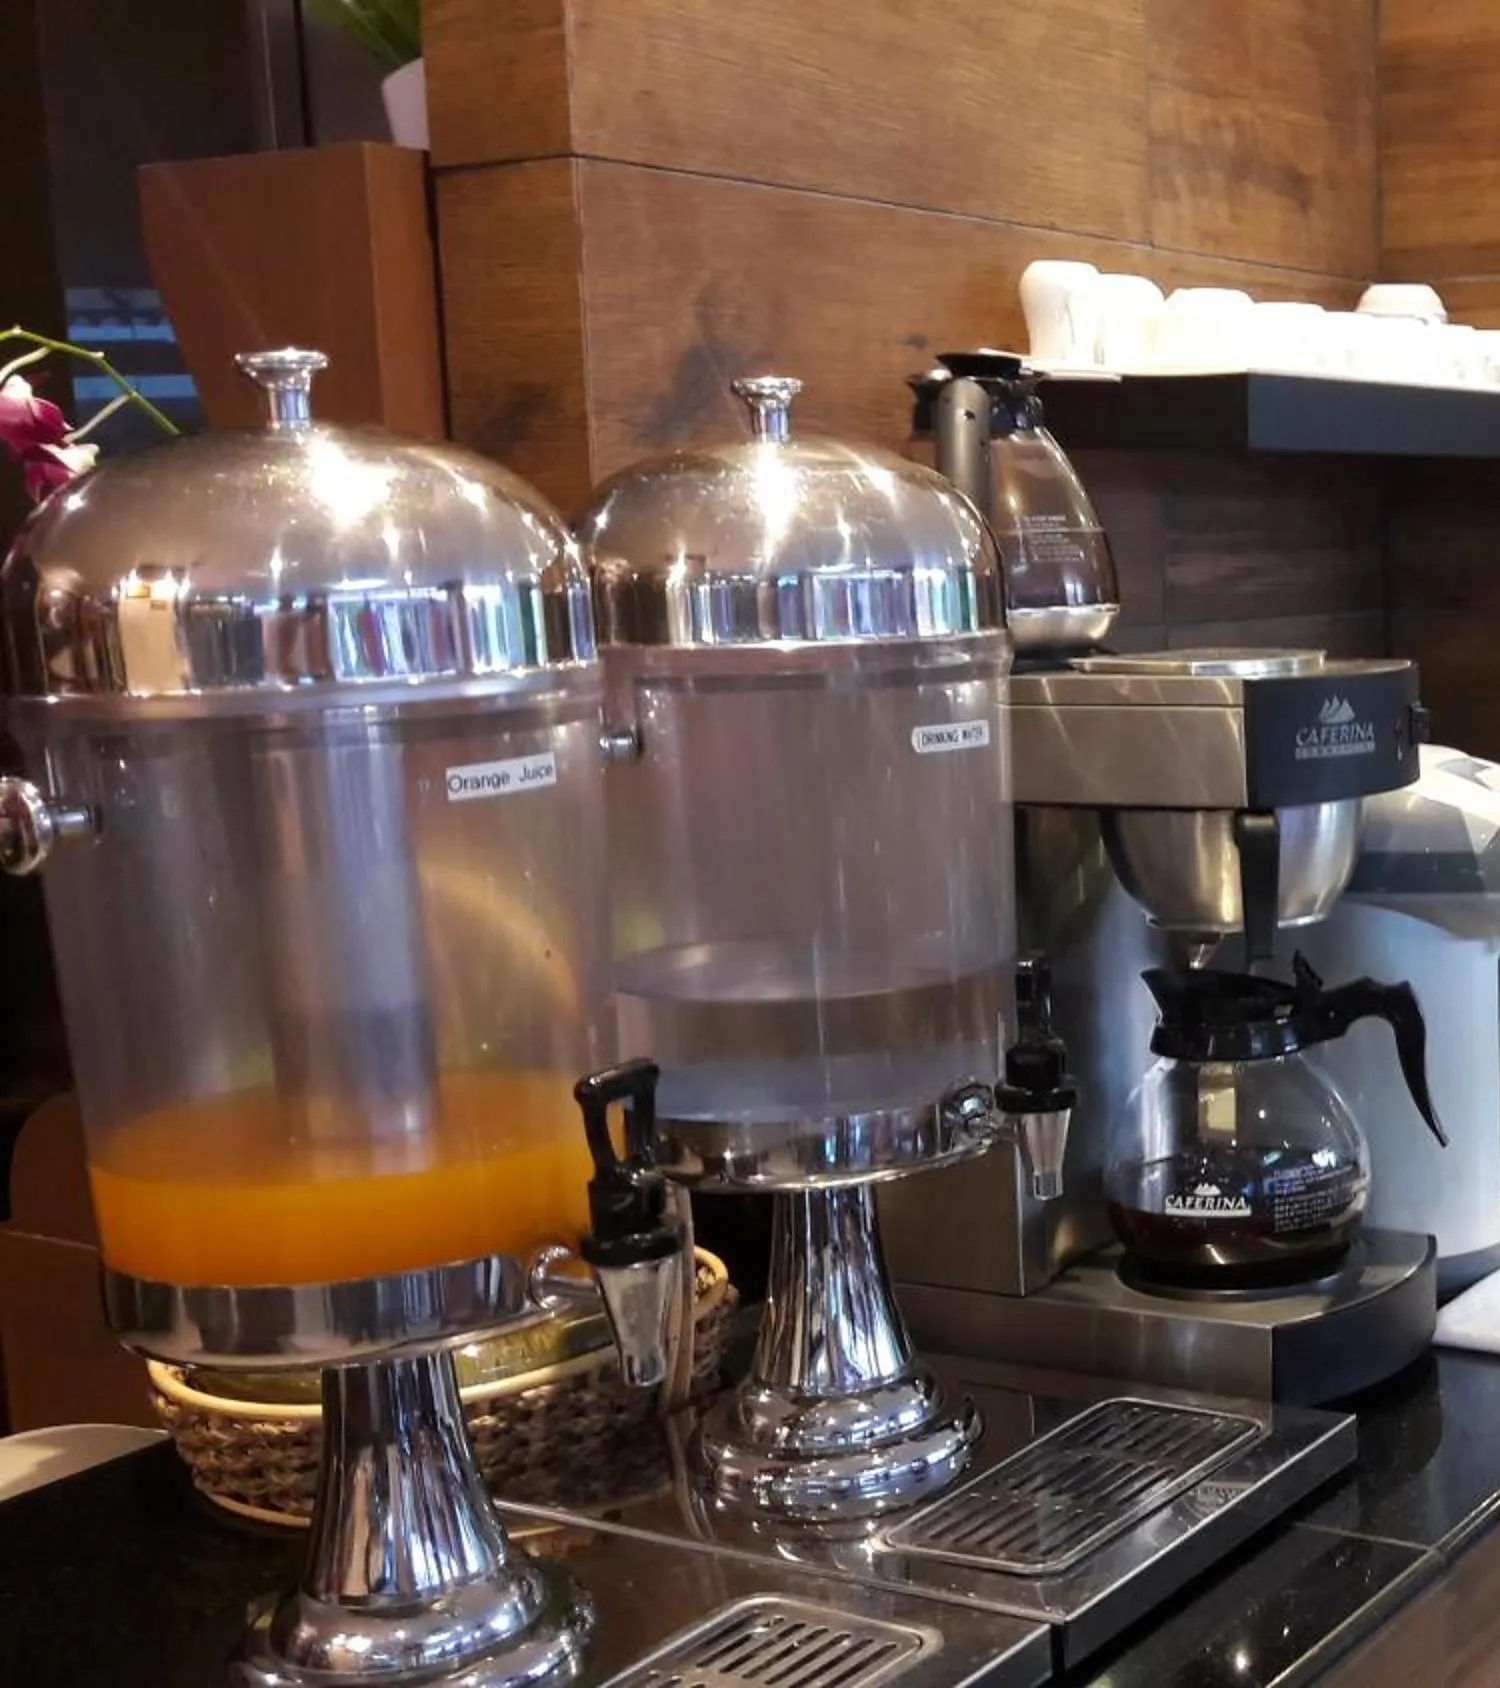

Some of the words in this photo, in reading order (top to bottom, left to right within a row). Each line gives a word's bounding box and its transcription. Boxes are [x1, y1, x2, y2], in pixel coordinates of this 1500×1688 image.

[1295, 721, 1375, 746] CAFERINA
[447, 771, 511, 793] Orange
[519, 763, 553, 783] Juice
[1165, 1194, 1249, 1211] CAFERINA
